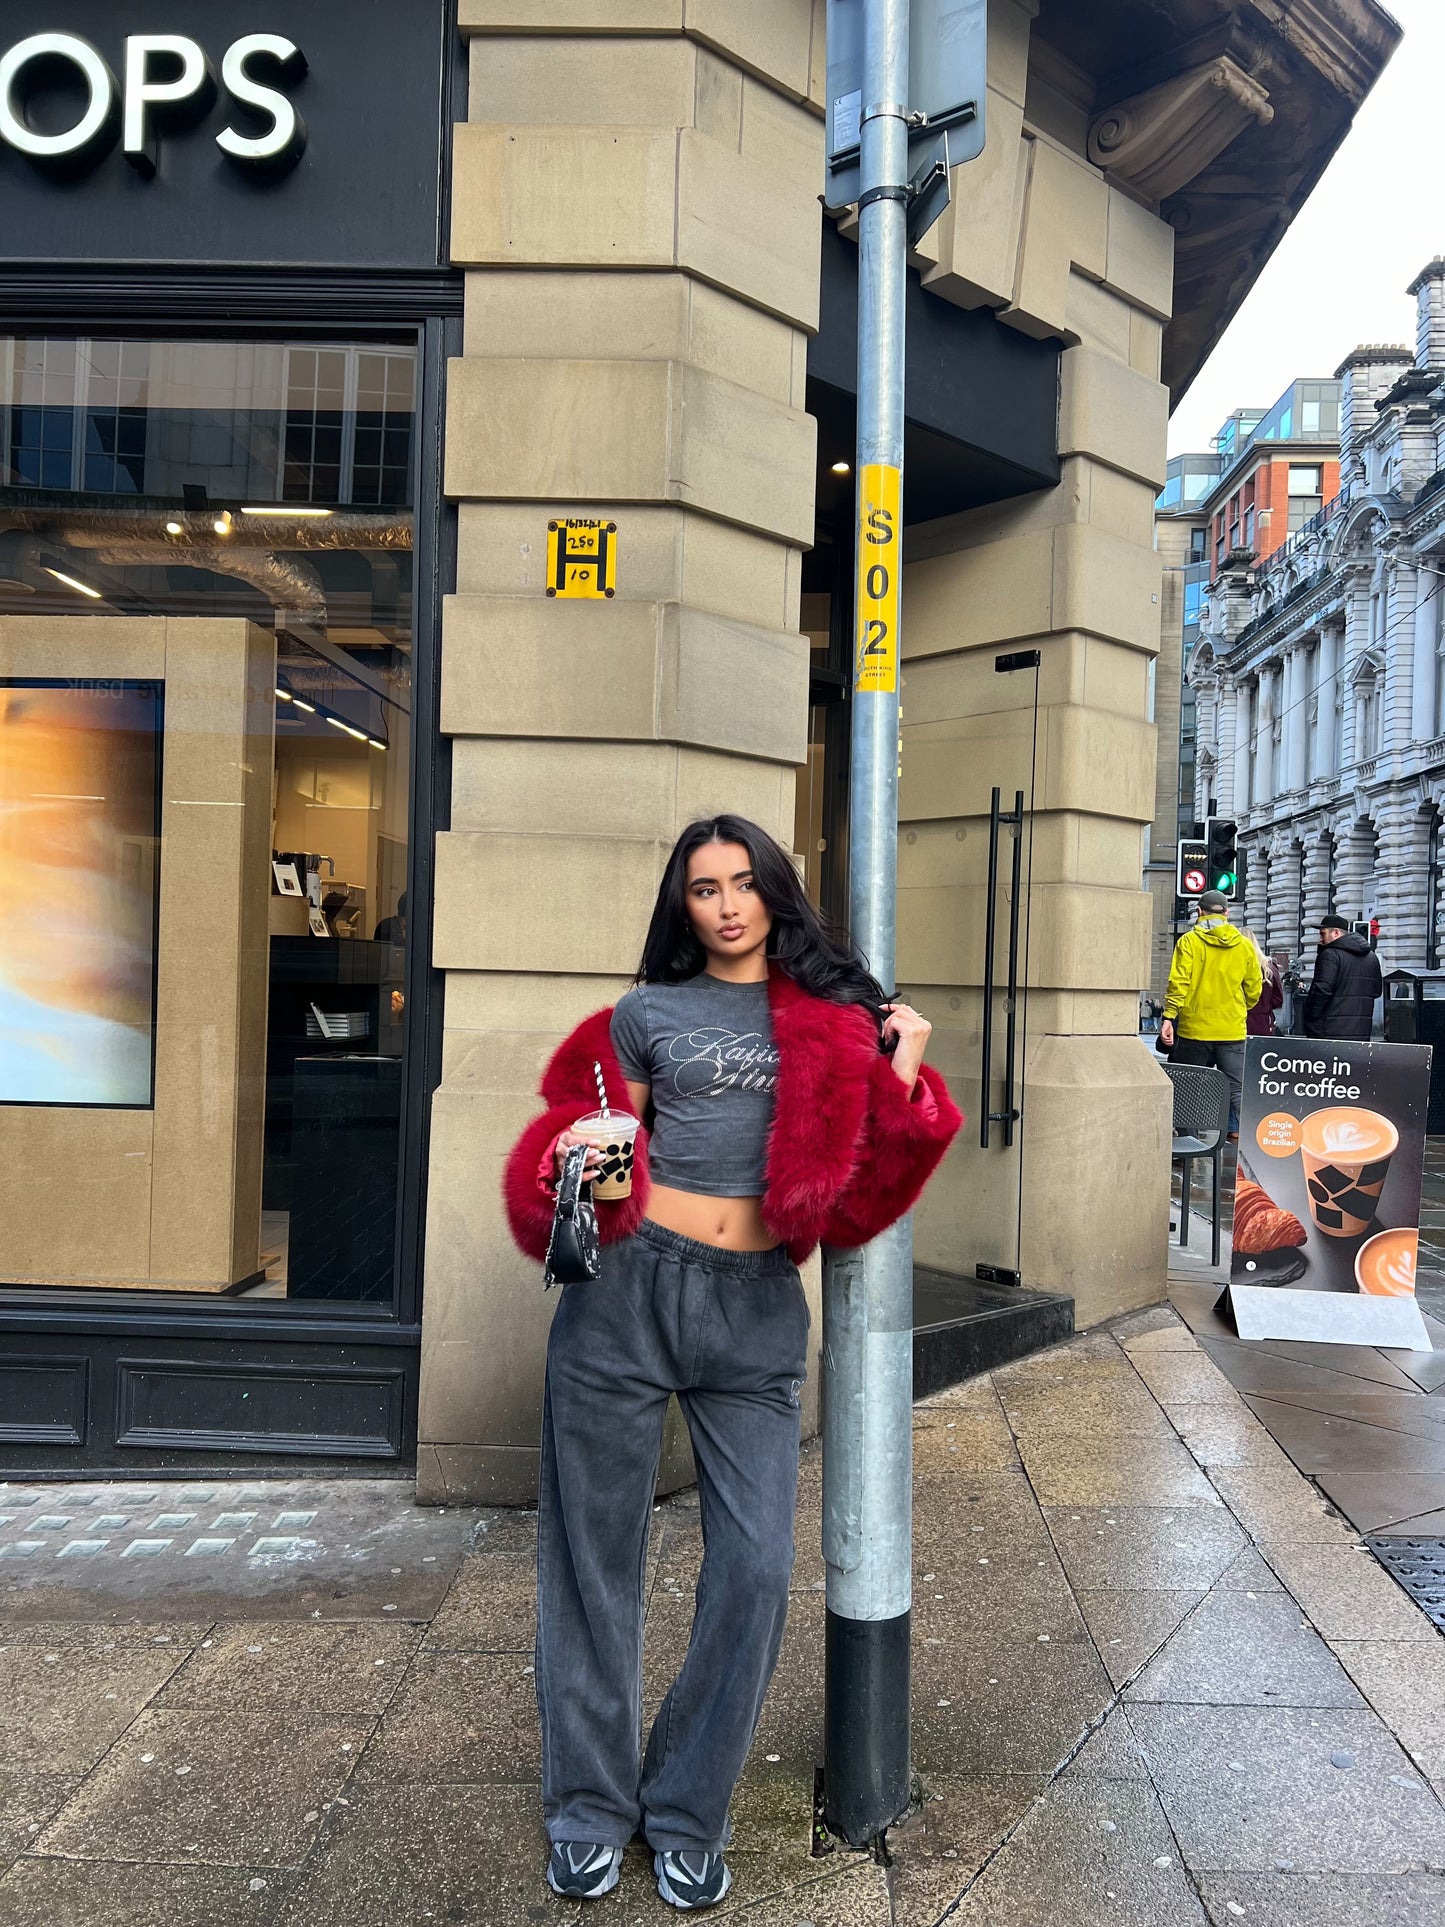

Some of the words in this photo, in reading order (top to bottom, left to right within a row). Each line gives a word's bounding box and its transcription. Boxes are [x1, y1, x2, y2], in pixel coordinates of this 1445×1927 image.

[0, 33, 297, 158] OPS
[567, 535, 594, 549] 250
[556, 528, 608, 591] H
[570, 568, 590, 580] 10
[1260, 1052, 1326, 1074] Come
[1332, 1056, 1351, 1076] in
[1258, 1074, 1289, 1095] for
[1294, 1078, 1360, 1099] coffee
[1268, 1120, 1293, 1130] Single
[1268, 1130, 1292, 1139] origin
[1262, 1138, 1296, 1147] Brazilian
